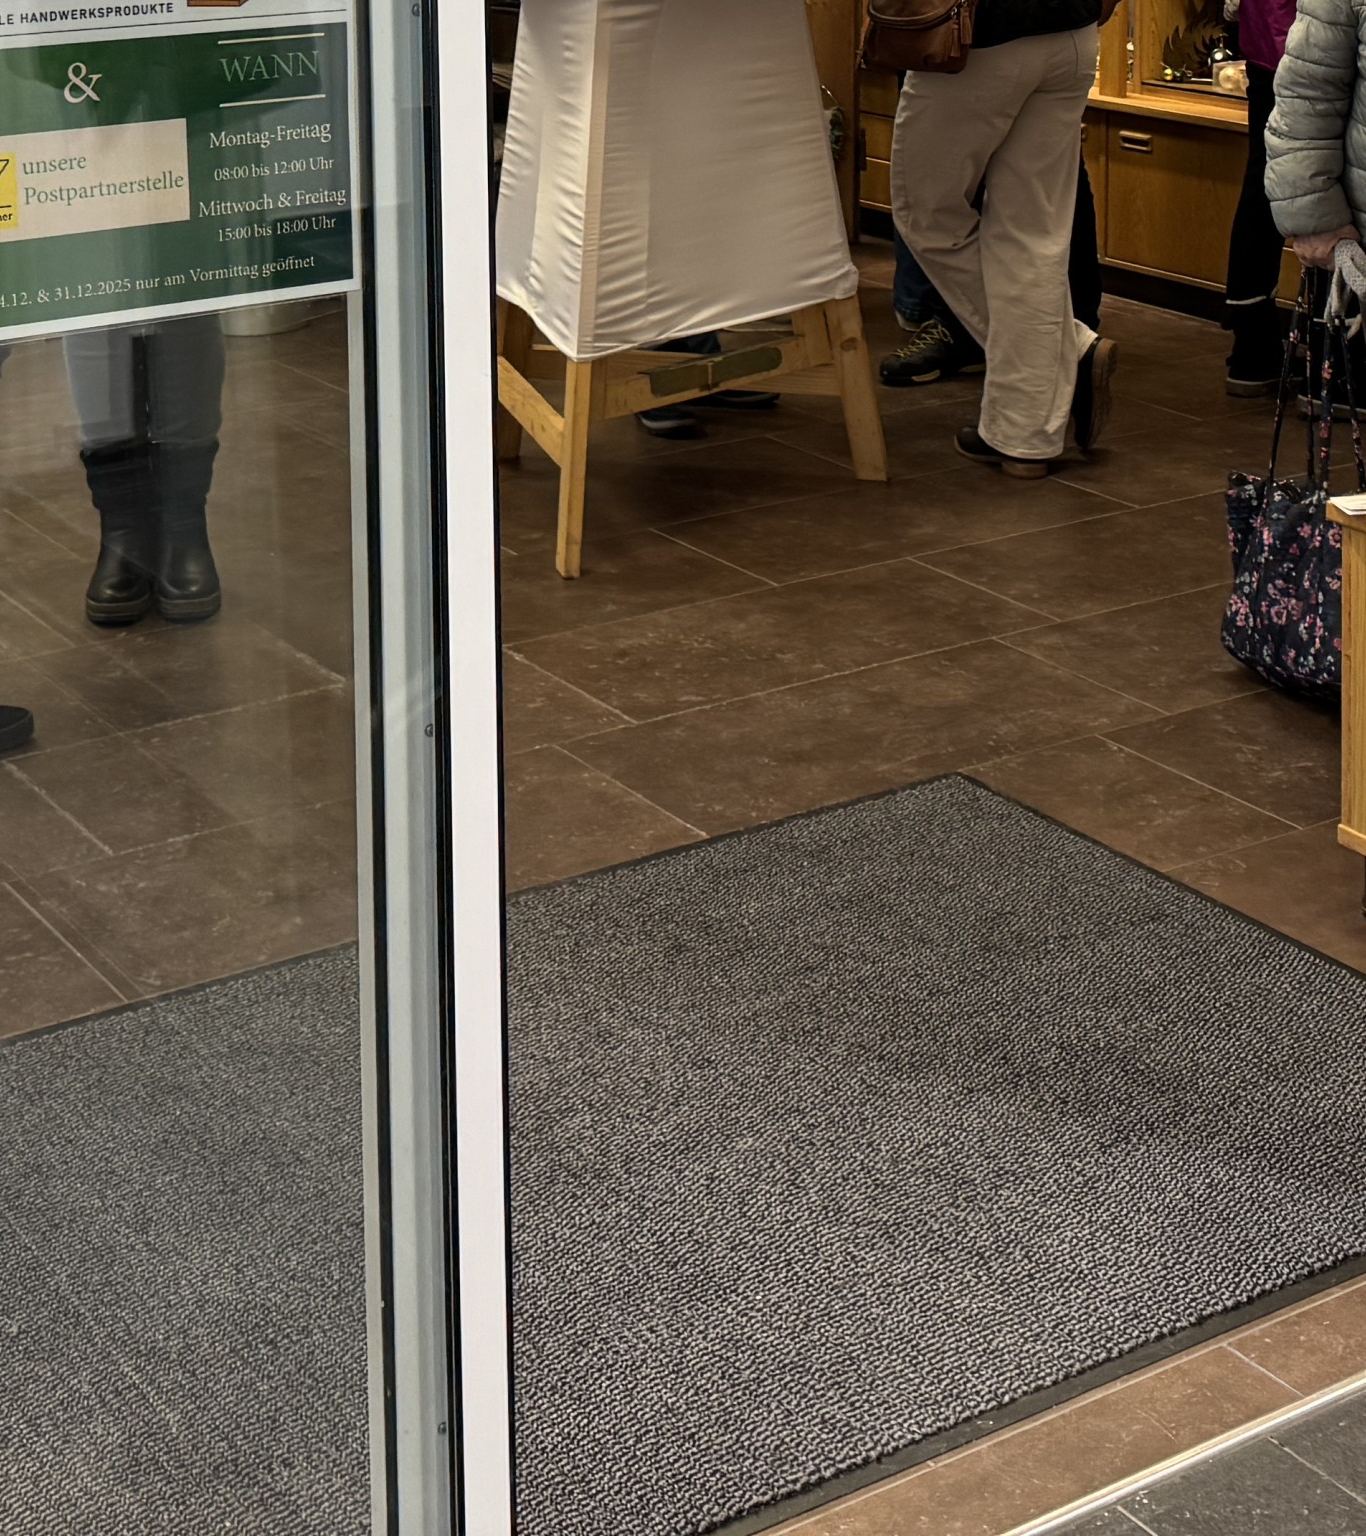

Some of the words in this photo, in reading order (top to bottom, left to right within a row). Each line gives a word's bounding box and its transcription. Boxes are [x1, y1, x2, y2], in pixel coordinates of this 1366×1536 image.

[20, 2, 174, 25] HANDWERKSPRODUKTE
[220, 50, 319, 82] WANN
[64, 62, 102, 104] &
[209, 122, 332, 149] Montag-Freitag
[22, 154, 87, 175] unsere
[214, 165, 247, 182] 08:00
[251, 163, 270, 178] bis
[274, 160, 306, 175] 12:00
[309, 156, 334, 171] Uhr
[24, 172, 184, 206] Postpartnerstelle
[199, 195, 273, 218] Mittwoch
[278, 192, 291, 209] &
[295, 187, 347, 207] Freitag
[218, 227, 251, 242] 15:00
[254, 223, 272, 238] bis
[276, 220, 309, 234] 18:00
[313, 216, 337, 231] Uhr
[37, 288, 51, 304] &
[54, 278, 131, 301] 31.12.2025
[136, 277, 161, 290] nur
[164, 274, 185, 287] am
[190, 263, 259, 284] Vormittag
[262, 256, 315, 275] geöffnet
